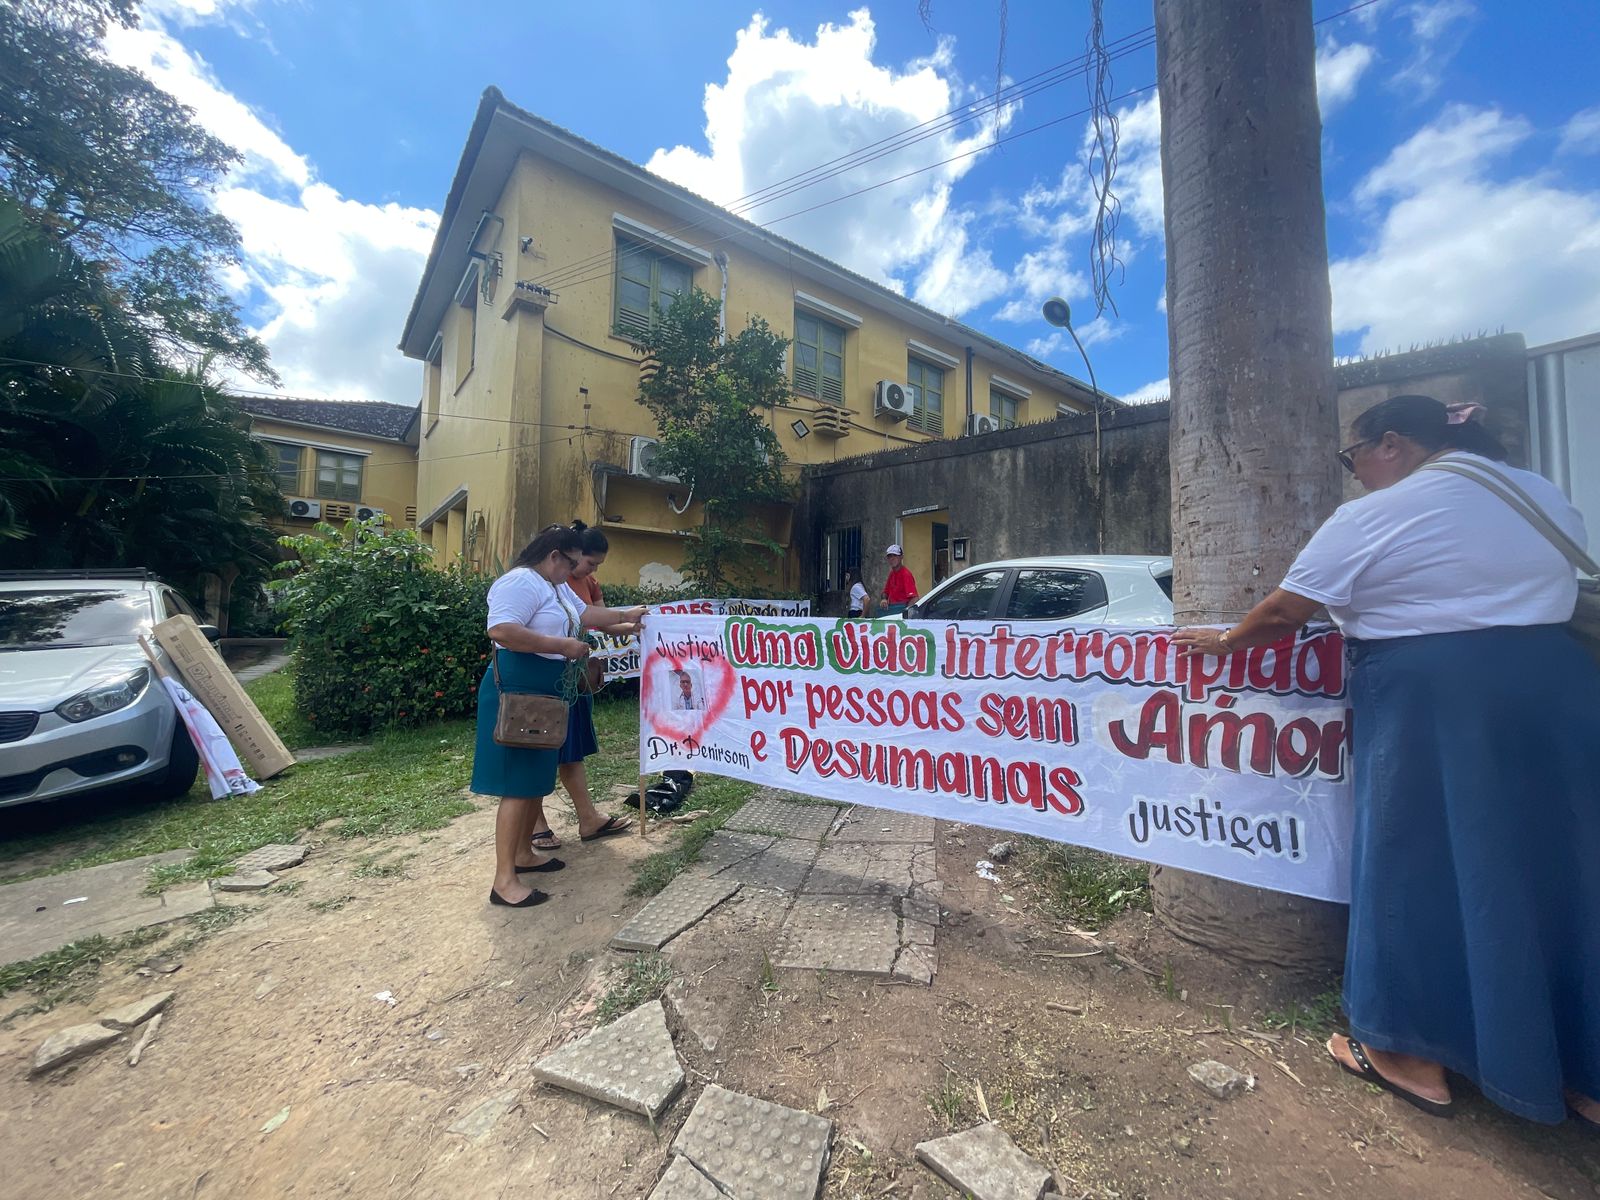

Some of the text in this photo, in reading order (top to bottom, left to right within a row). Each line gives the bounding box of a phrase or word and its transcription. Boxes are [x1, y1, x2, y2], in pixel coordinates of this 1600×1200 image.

[656, 632, 725, 662] Justiça!
[728, 620, 1346, 701] Uma Vida Interrompida
[740, 674, 794, 719] por
[805, 682, 966, 732] pessoas
[979, 692, 1079, 746] sem
[647, 735, 750, 770] Dr. Denirsom
[750, 726, 1085, 816] e Desumanas
[1129, 798, 1300, 858] Justiça!
